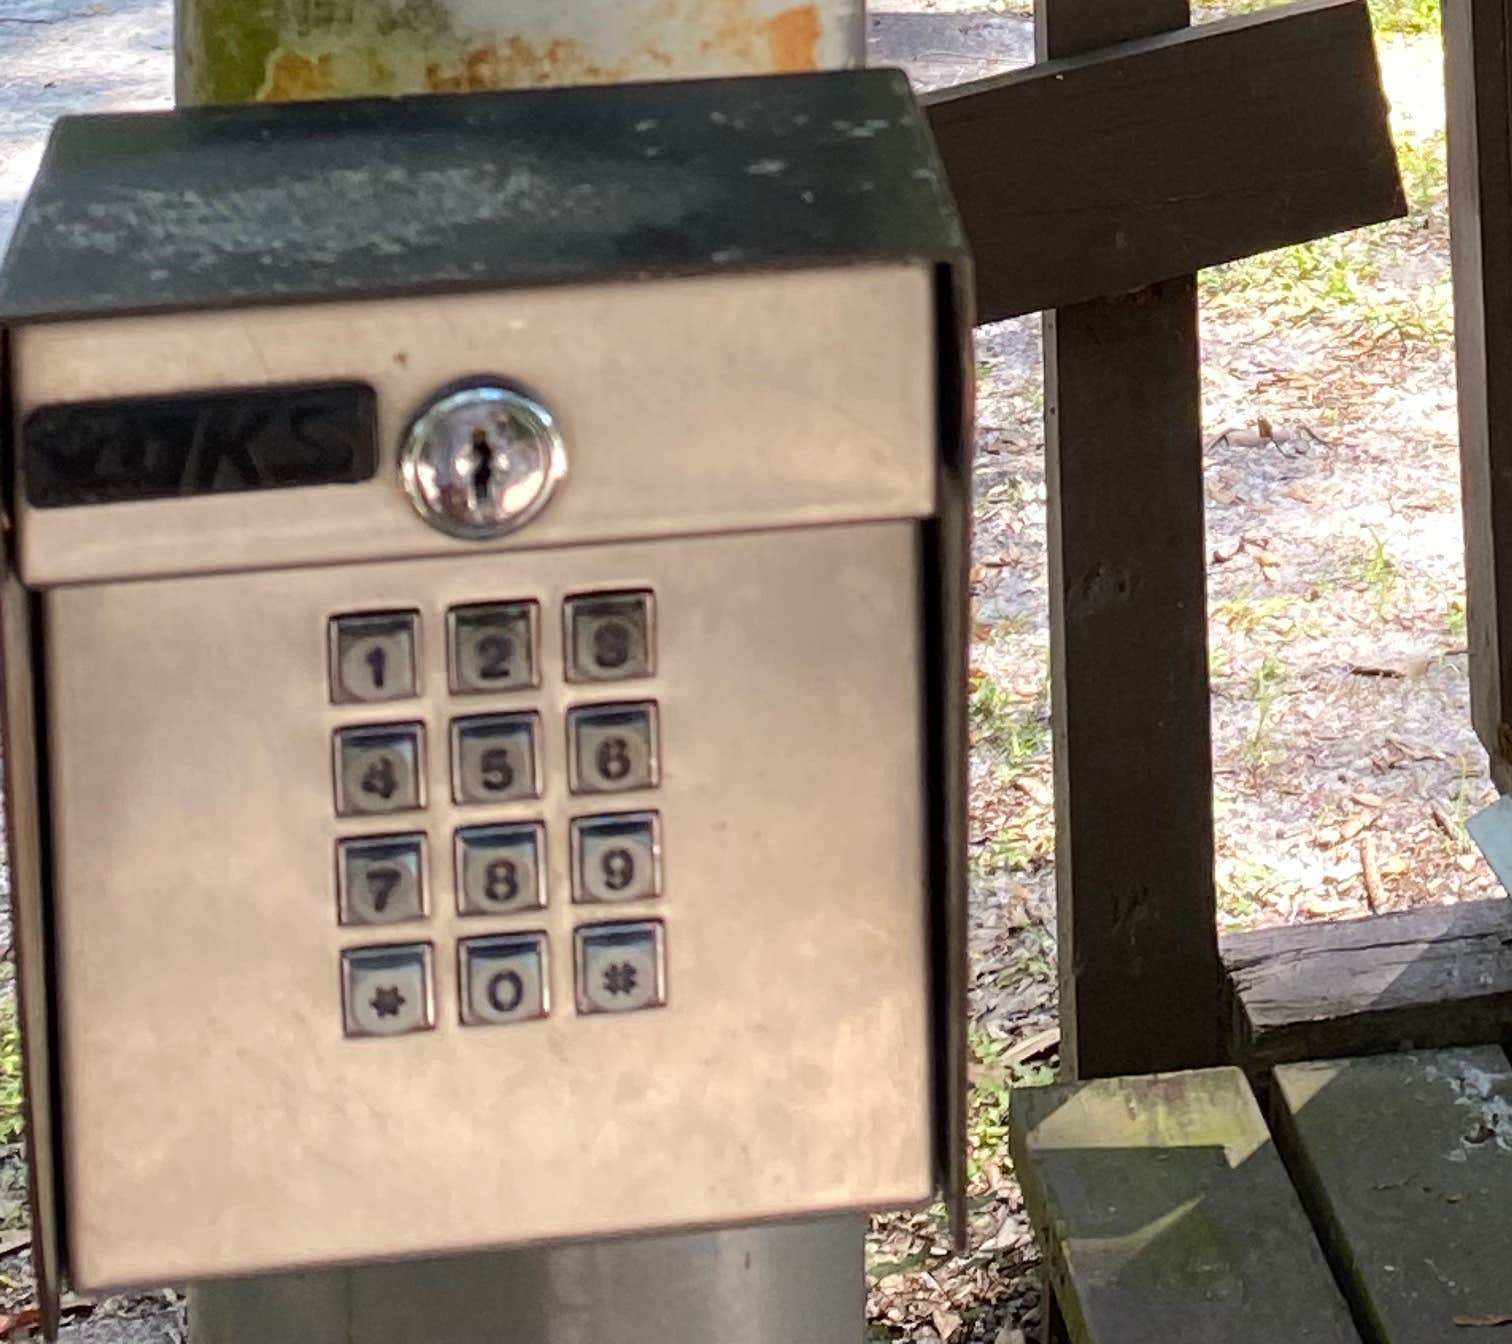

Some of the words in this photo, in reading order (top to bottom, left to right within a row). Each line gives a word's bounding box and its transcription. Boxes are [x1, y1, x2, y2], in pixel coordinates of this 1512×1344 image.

[365, 645, 386, 690] 1
[476, 636, 513, 680] 2
[361, 756, 398, 800] 4
[480, 748, 515, 791] 5
[598, 737, 631, 781] 6
[365, 868, 401, 913] 7
[484, 861, 518, 903] 8
[600, 848, 634, 891] 9
[487, 970, 523, 1012] 0
